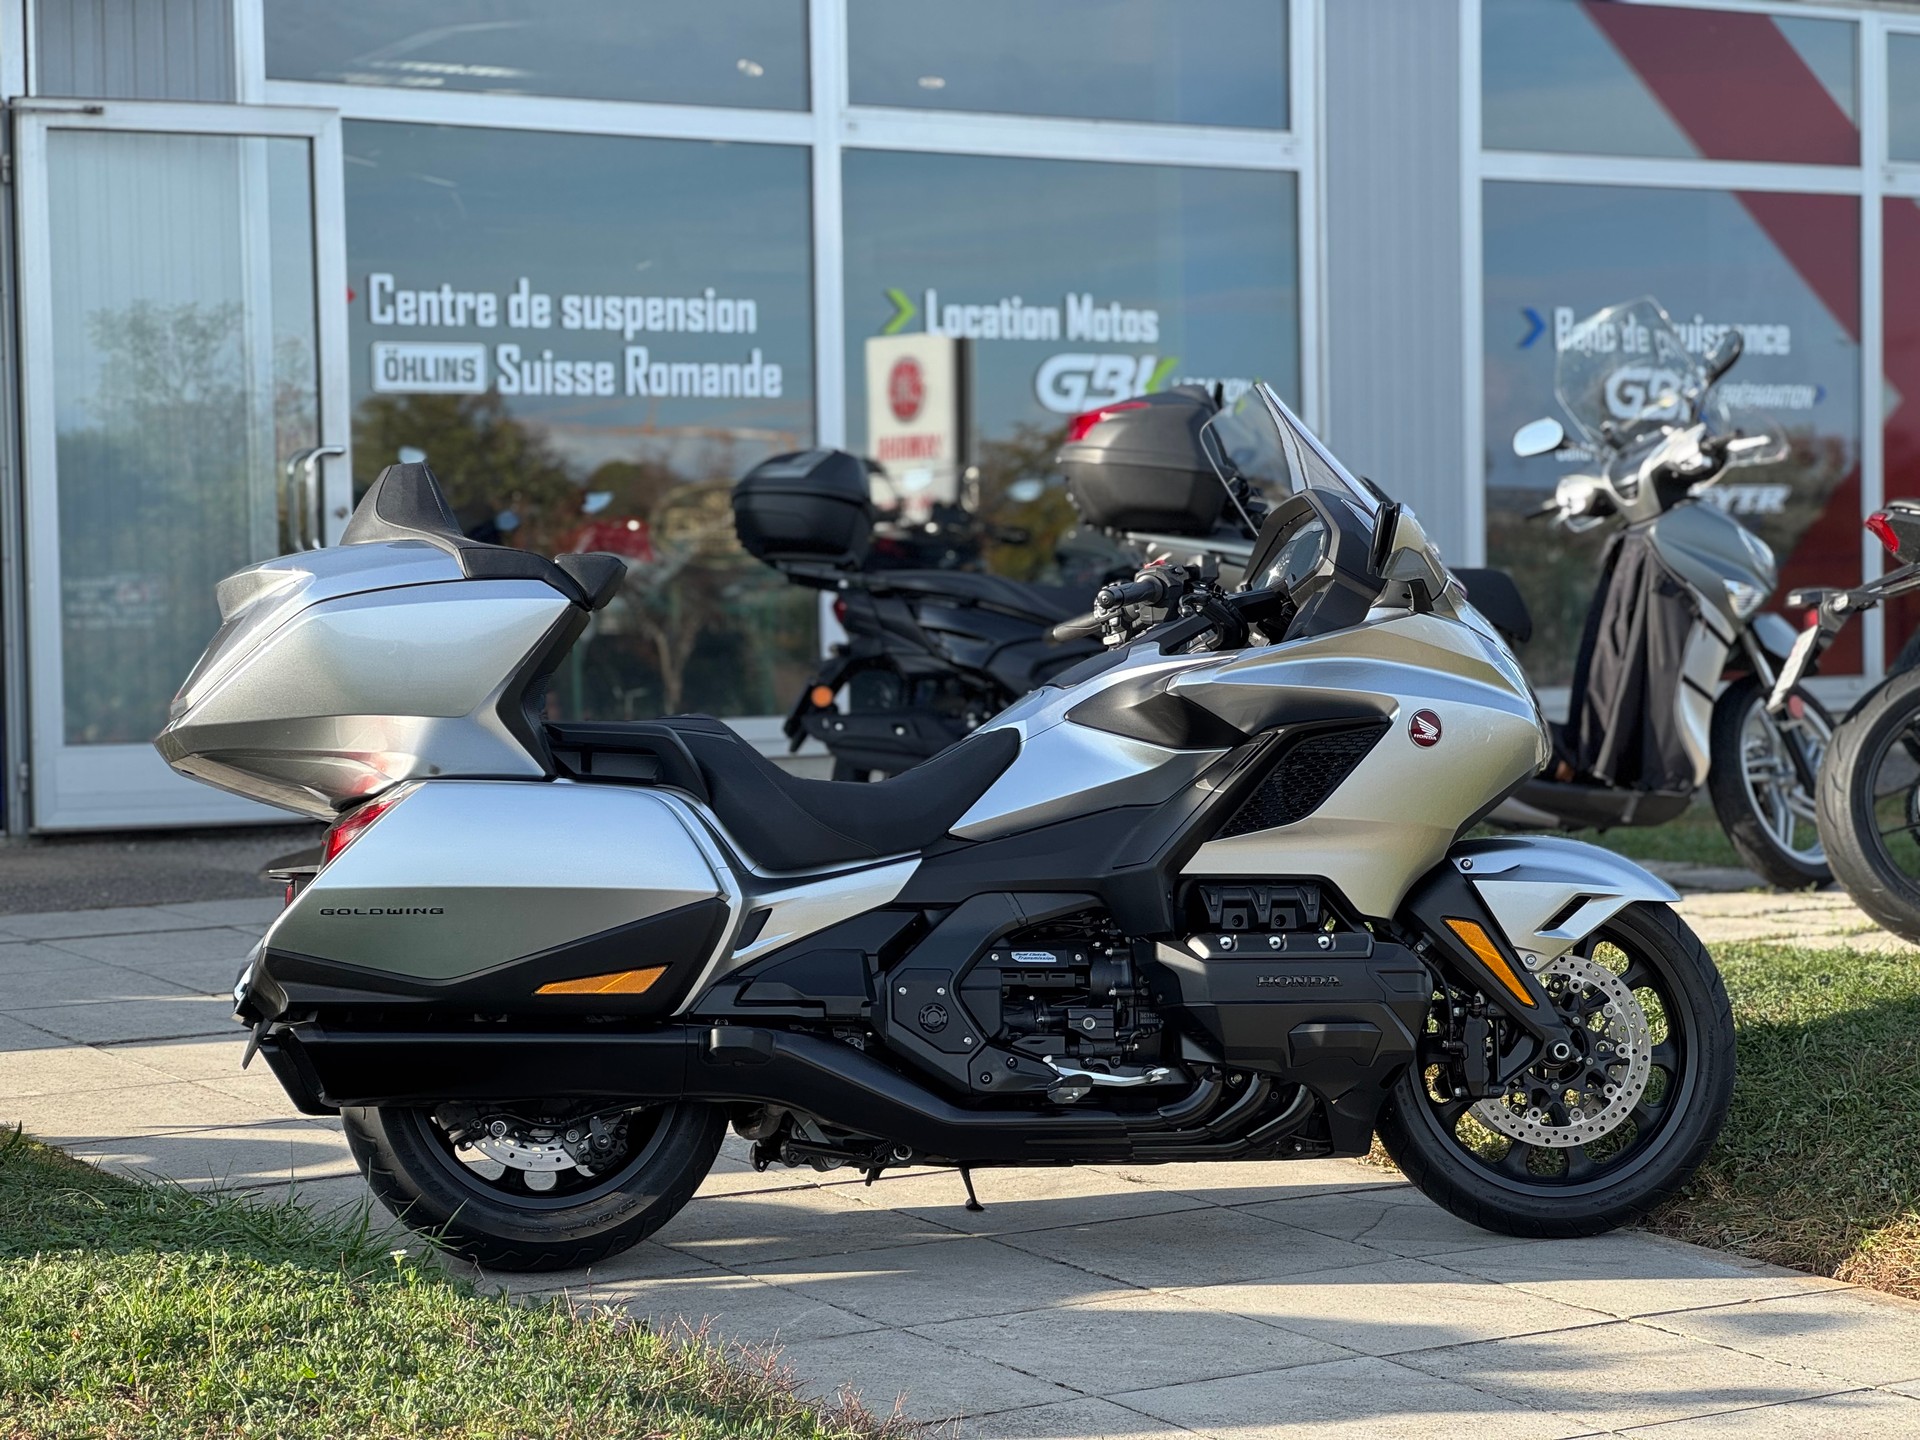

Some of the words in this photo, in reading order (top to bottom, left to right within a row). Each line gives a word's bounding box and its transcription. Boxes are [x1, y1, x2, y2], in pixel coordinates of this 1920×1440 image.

[368, 273, 498, 327] Centre
[508, 277, 551, 328] de
[561, 288, 757, 341] suspension
[925, 288, 1060, 341] Location
[1066, 292, 1159, 343] Motos
[1622, 313, 1651, 353] de
[384, 348, 477, 383] ÖHLINS
[497, 344, 615, 396] Suisse
[624, 346, 783, 398] Romande
[1413, 733, 1437, 741] HONDA
[320, 907, 445, 916] GOLDWING
[1256, 974, 1343, 988] HONDA
